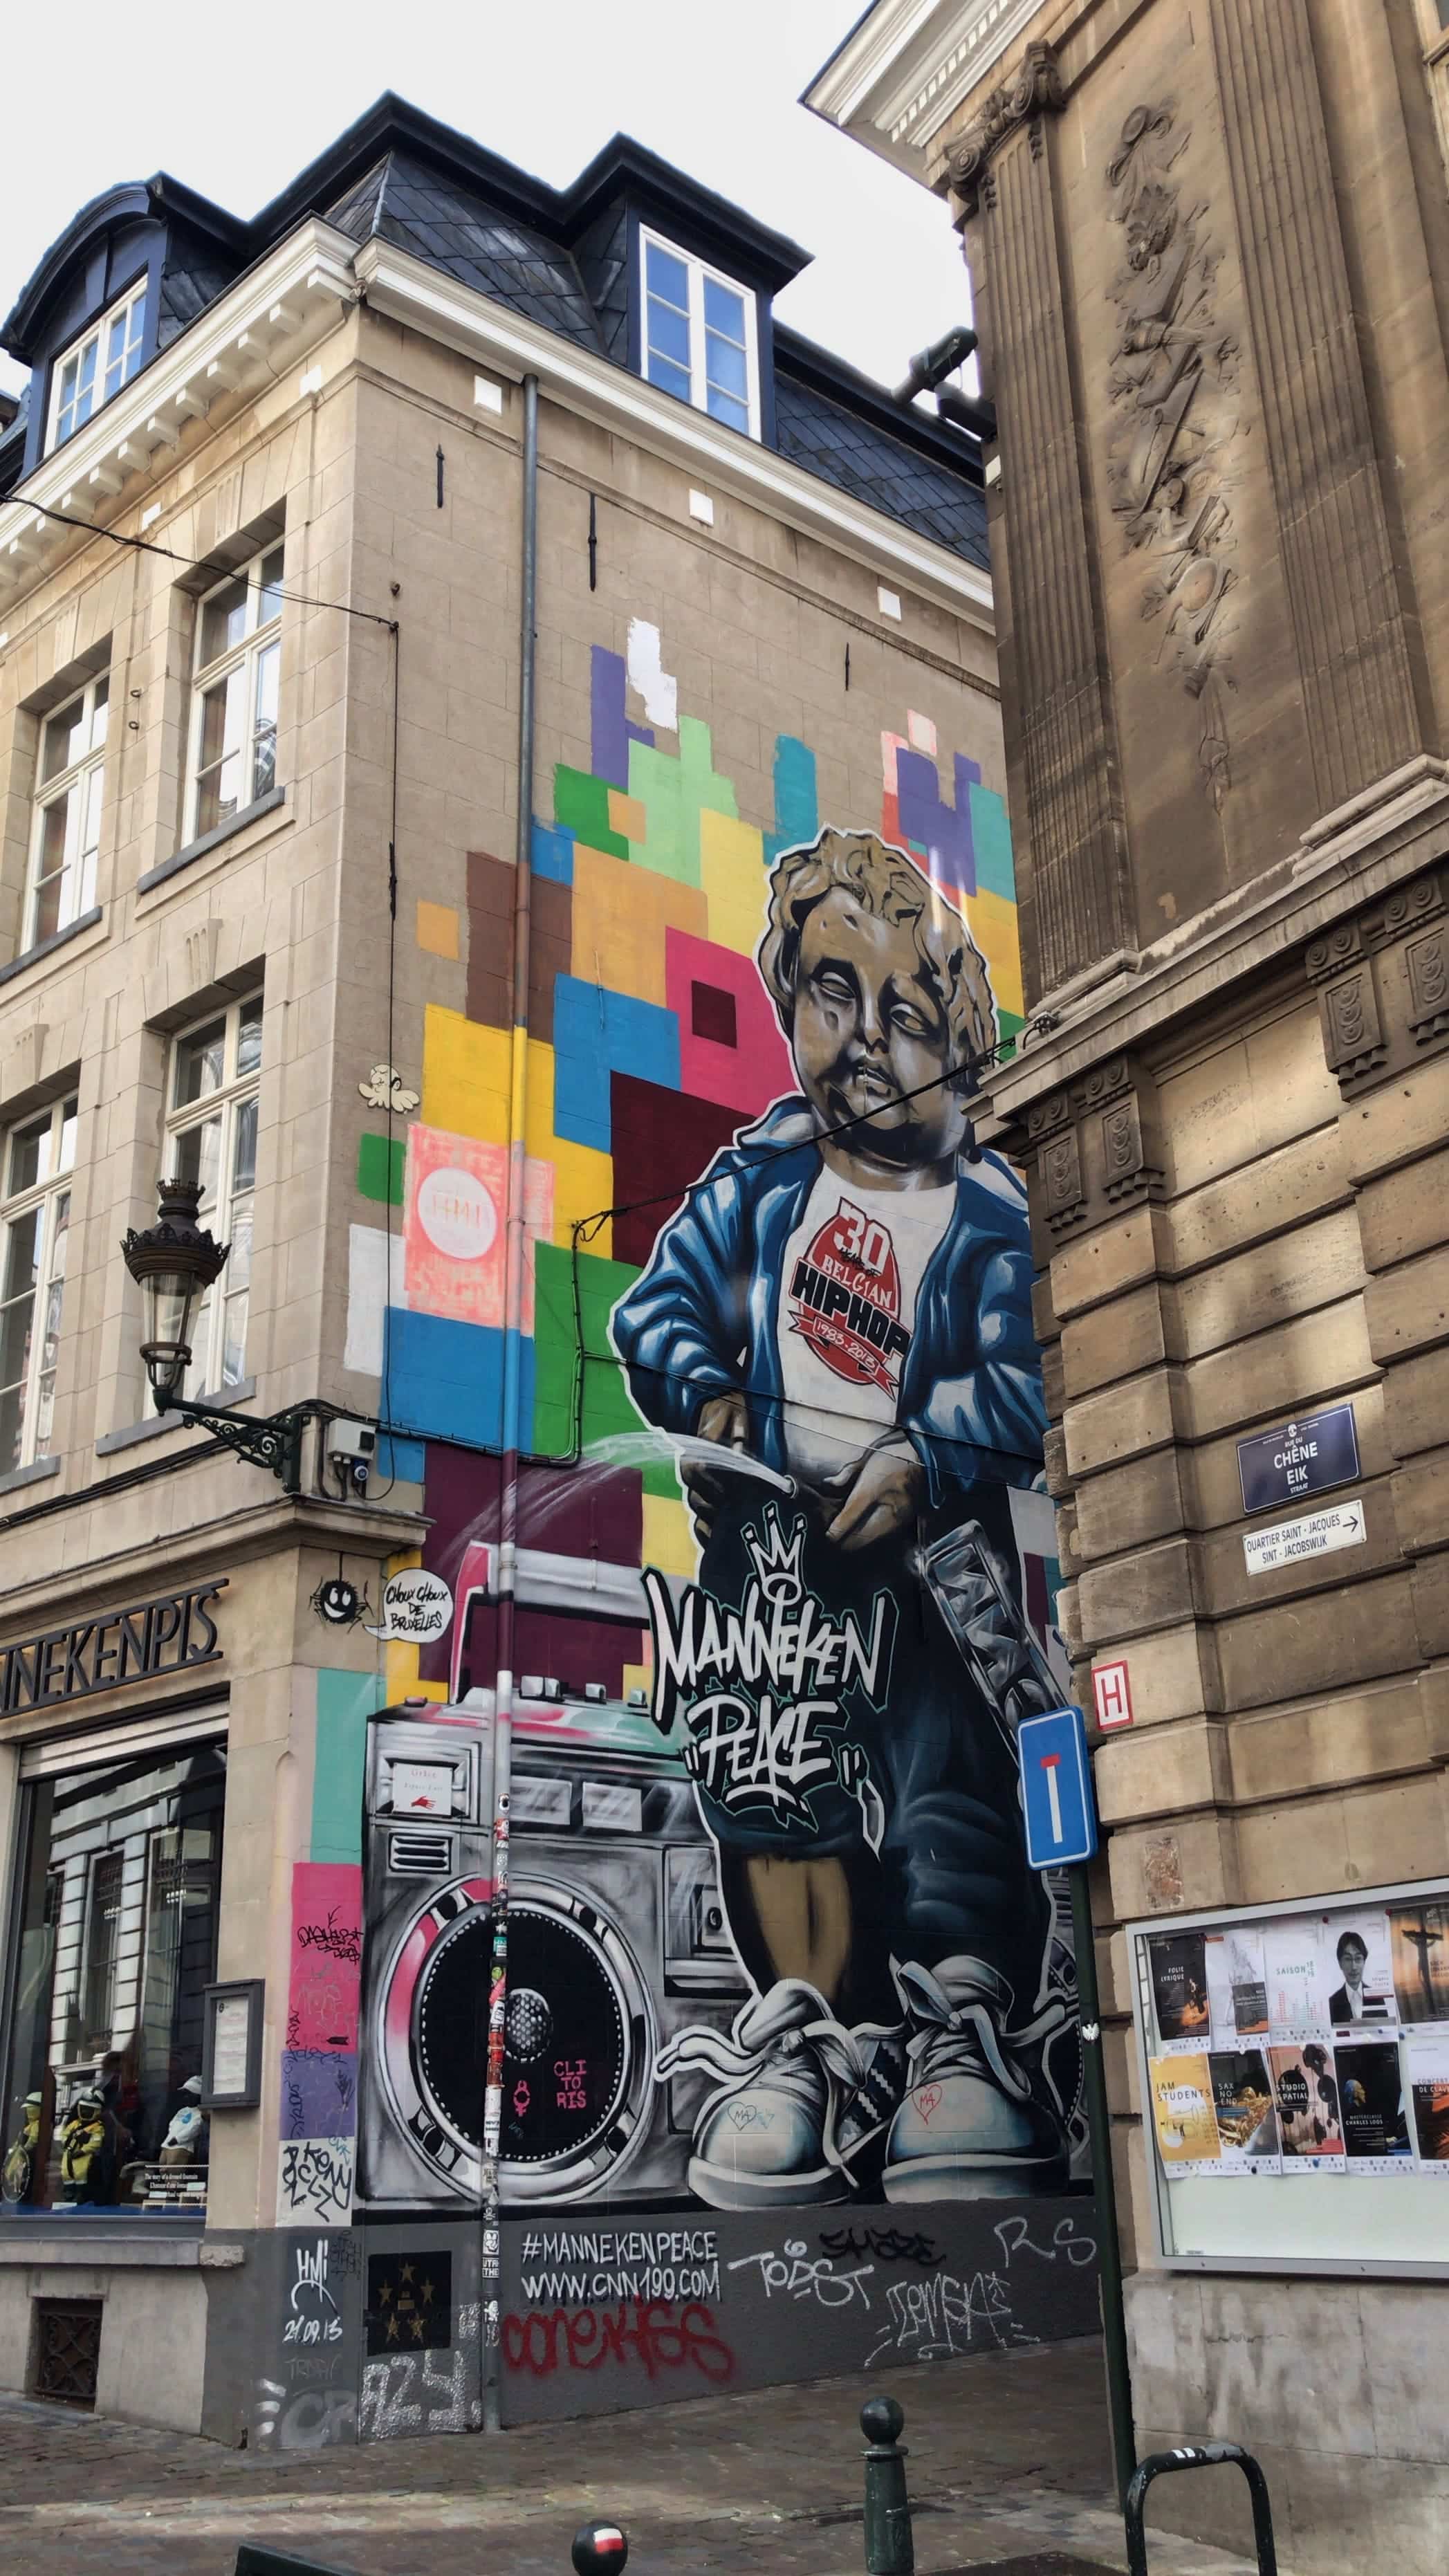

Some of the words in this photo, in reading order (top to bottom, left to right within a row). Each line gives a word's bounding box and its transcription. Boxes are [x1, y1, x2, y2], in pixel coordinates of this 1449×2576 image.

[833, 1197, 893, 1276] 30
[821, 1254, 893, 1309] BELGIAN
[1295, 1436, 1303, 1444] DU
[1274, 1442, 1318, 1469] CHÊNE
[1286, 1465, 1309, 1485] EIK
[1290, 1482, 1309, 1494] STRAAT
[1246, 1532, 1280, 1553] QUARTIER
[1282, 1525, 1302, 1542] SAINT
[1308, 1514, 1340, 1534] JACQUES
[1262, 1549, 1277, 1564] SINT
[1284, 1534, 1328, 1558] JACOBSWIJK
[408, 1601, 426, 1616] DE
[390, 1610, 443, 1632] BRUXELLES
[645, 1572, 887, 1722] MANNEKEN
[1100, 1673, 1123, 1718] H
[1276, 1965, 1306, 1976] SAISON
[560, 2077, 582, 2090] TO
[1156, 2081, 1175, 2092] JAM
[1276, 2083, 1306, 2092] STUDIO
[556, 2090, 587, 2109] RIS
[1158, 2088, 1211, 2102] STUDENTS
[1276, 2092, 1308, 2101] SPATIAL
[522, 2230, 719, 2266] #MANNEKENPEACE
